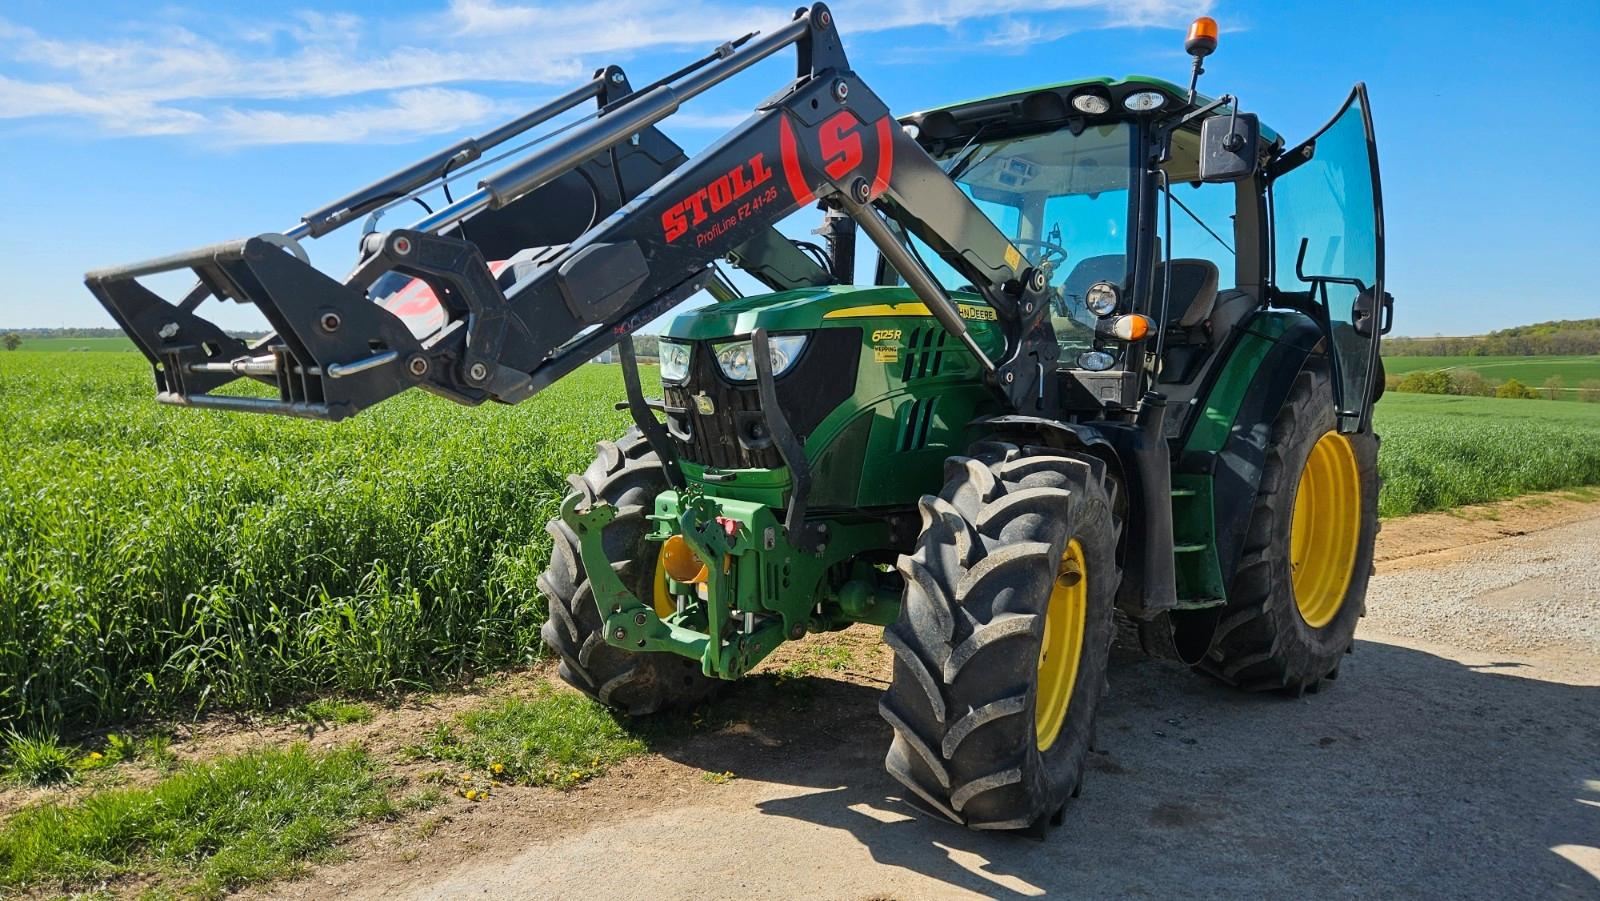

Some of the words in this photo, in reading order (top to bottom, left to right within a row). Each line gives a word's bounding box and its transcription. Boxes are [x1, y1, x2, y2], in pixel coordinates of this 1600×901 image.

[820, 112, 863, 181] S
[661, 153, 773, 243] STOLL
[696, 214, 737, 249] ProfiLine
[737, 205, 752, 221] FZ
[752, 186, 778, 211] 41-25
